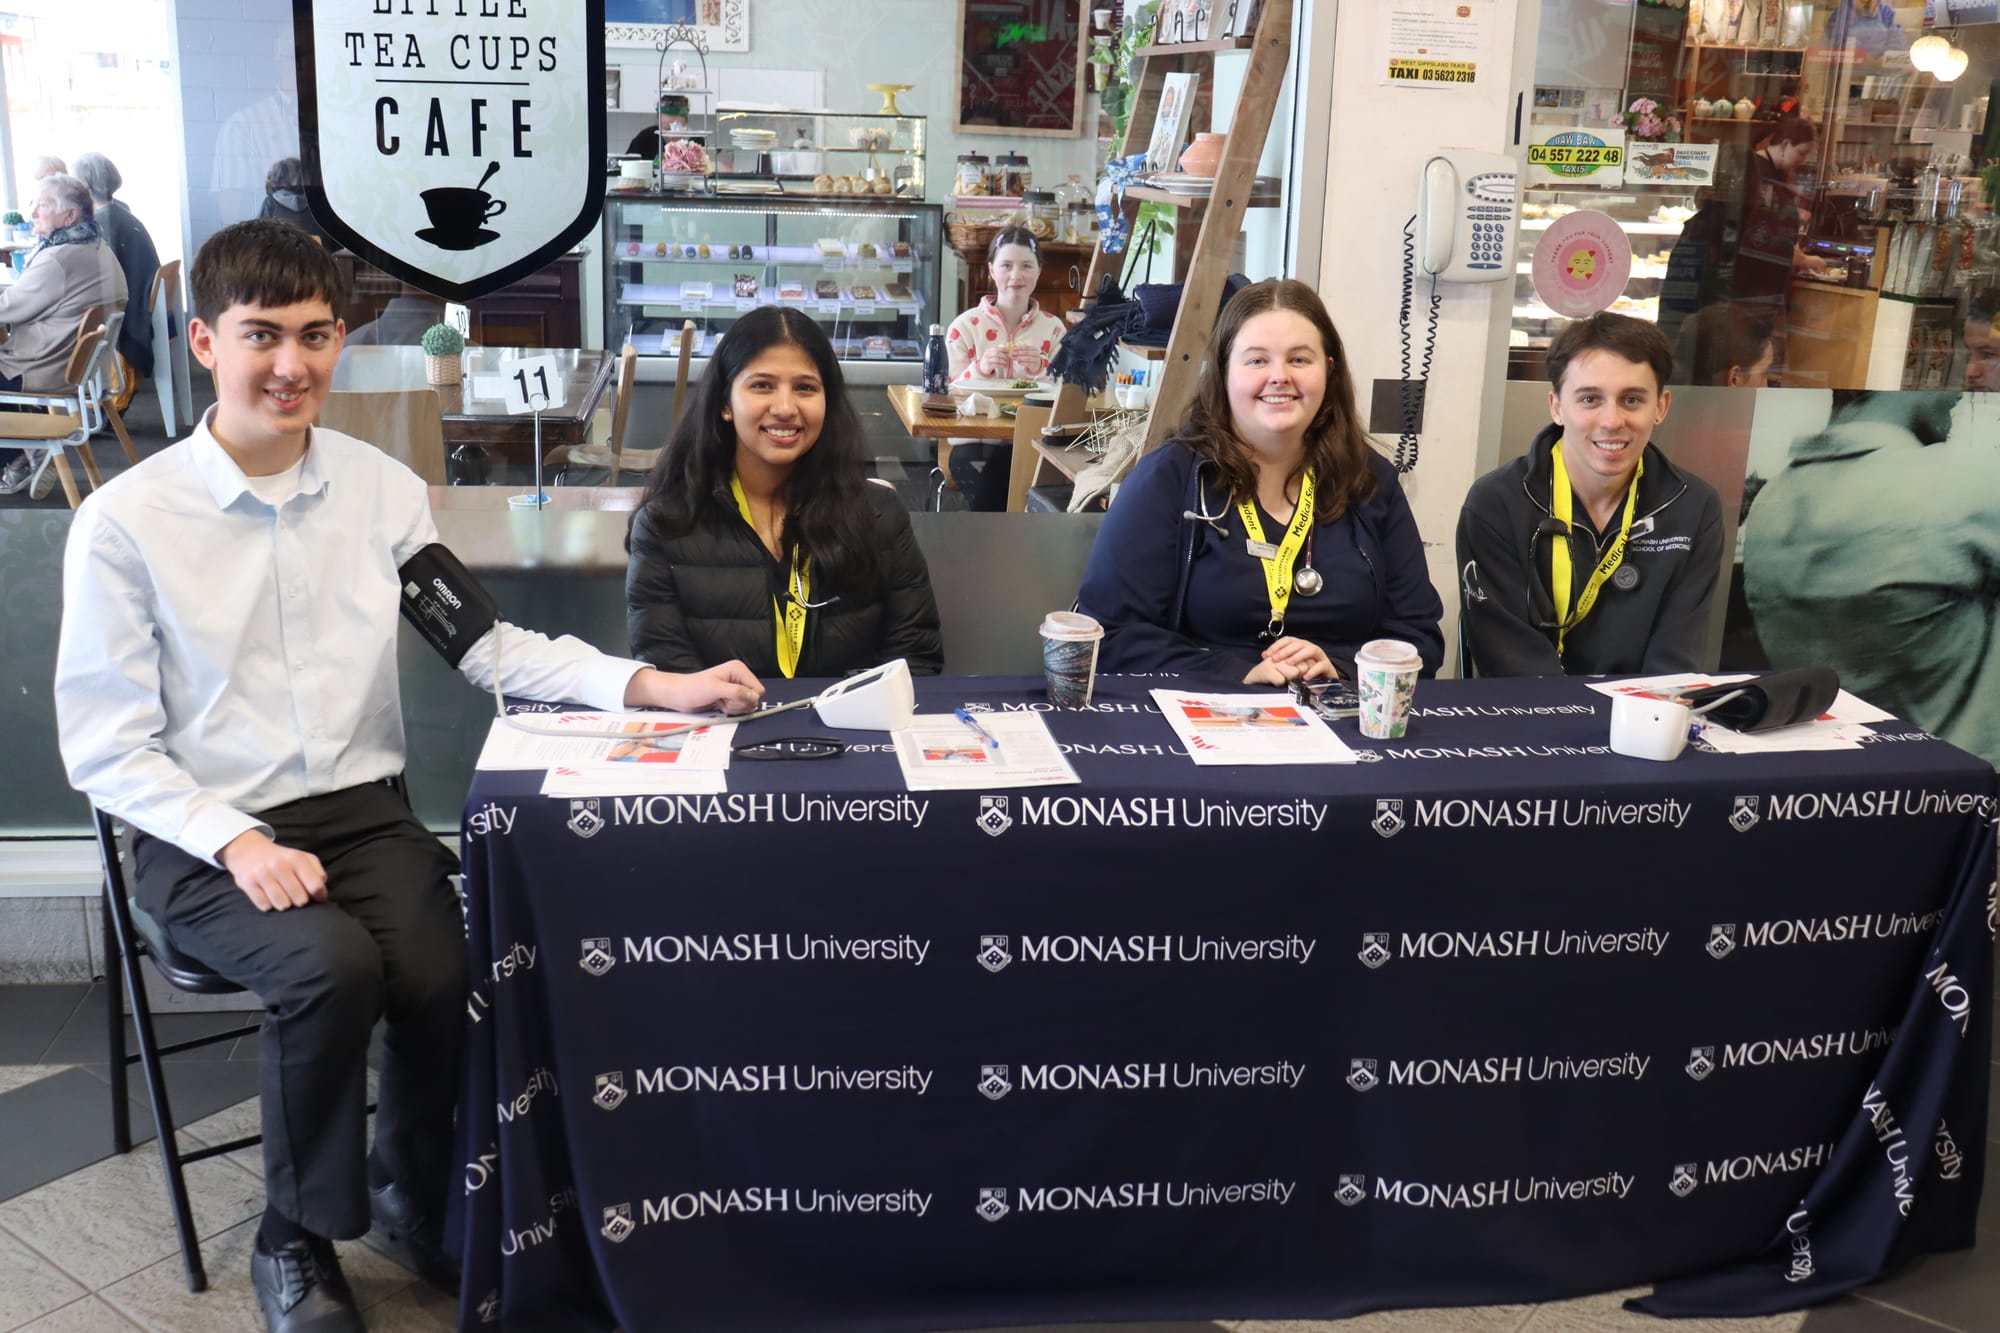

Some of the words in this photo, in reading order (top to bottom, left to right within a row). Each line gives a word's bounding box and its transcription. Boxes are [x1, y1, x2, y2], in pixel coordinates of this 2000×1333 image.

[345, 32, 426, 68] TEA
[450, 34, 558, 72] CUPS
[1389, 67, 1419, 79] TAXI
[1422, 68, 1434, 80] 03
[1434, 70, 1455, 82] 5623
[1456, 71, 1476, 83] 2318
[375, 96, 532, 158] CAFE
[1531, 148, 1547, 161] 04
[1549, 148, 1573, 162] 557
[1576, 149, 1600, 162] 222
[1603, 150, 1619, 163] 48
[1561, 165, 1585, 173] TAXIS
[456, 309, 467, 333] 10
[513, 365, 550, 404] 11
[1292, 498, 1312, 537] Medical
[1477, 704, 1595, 716] University
[1386, 746, 1528, 760] MONASH
[614, 796, 774, 826] MONASH
[782, 794, 930, 829] University
[1020, 795, 1177, 827] MONASH
[1181, 797, 1328, 832] University
[1413, 799, 1558, 828] MONASH
[1562, 797, 1692, 829] University
[1767, 790, 1901, 821] MONASH
[1399, 929, 1540, 959] MONASH
[1544, 927, 1670, 958] University
[1743, 914, 1872, 948] MONASH
[623, 933, 780, 964] MONASH
[785, 931, 931, 967] University
[1020, 935, 1172, 963] MONASH
[1178, 932, 1317, 965] University
[1721, 1032, 1845, 1069] MONASH
[635, 1064, 787, 1095] MONASH
[793, 1063, 934, 1097] University
[1020, 1062, 1167, 1091] MONASH
[1173, 1060, 1306, 1090] University
[1387, 1056, 1527, 1086] MONASH
[1527, 1051, 1651, 1083] University
[1704, 1143, 1824, 1185] MONASH
[642, 1187, 789, 1225] MONASH
[795, 1187, 933, 1220] University
[1017, 1181, 1161, 1212] MONASH
[1166, 1178, 1296, 1209] University
[1374, 1176, 1510, 1209] MONASH
[1514, 1171, 1635, 1205] University
